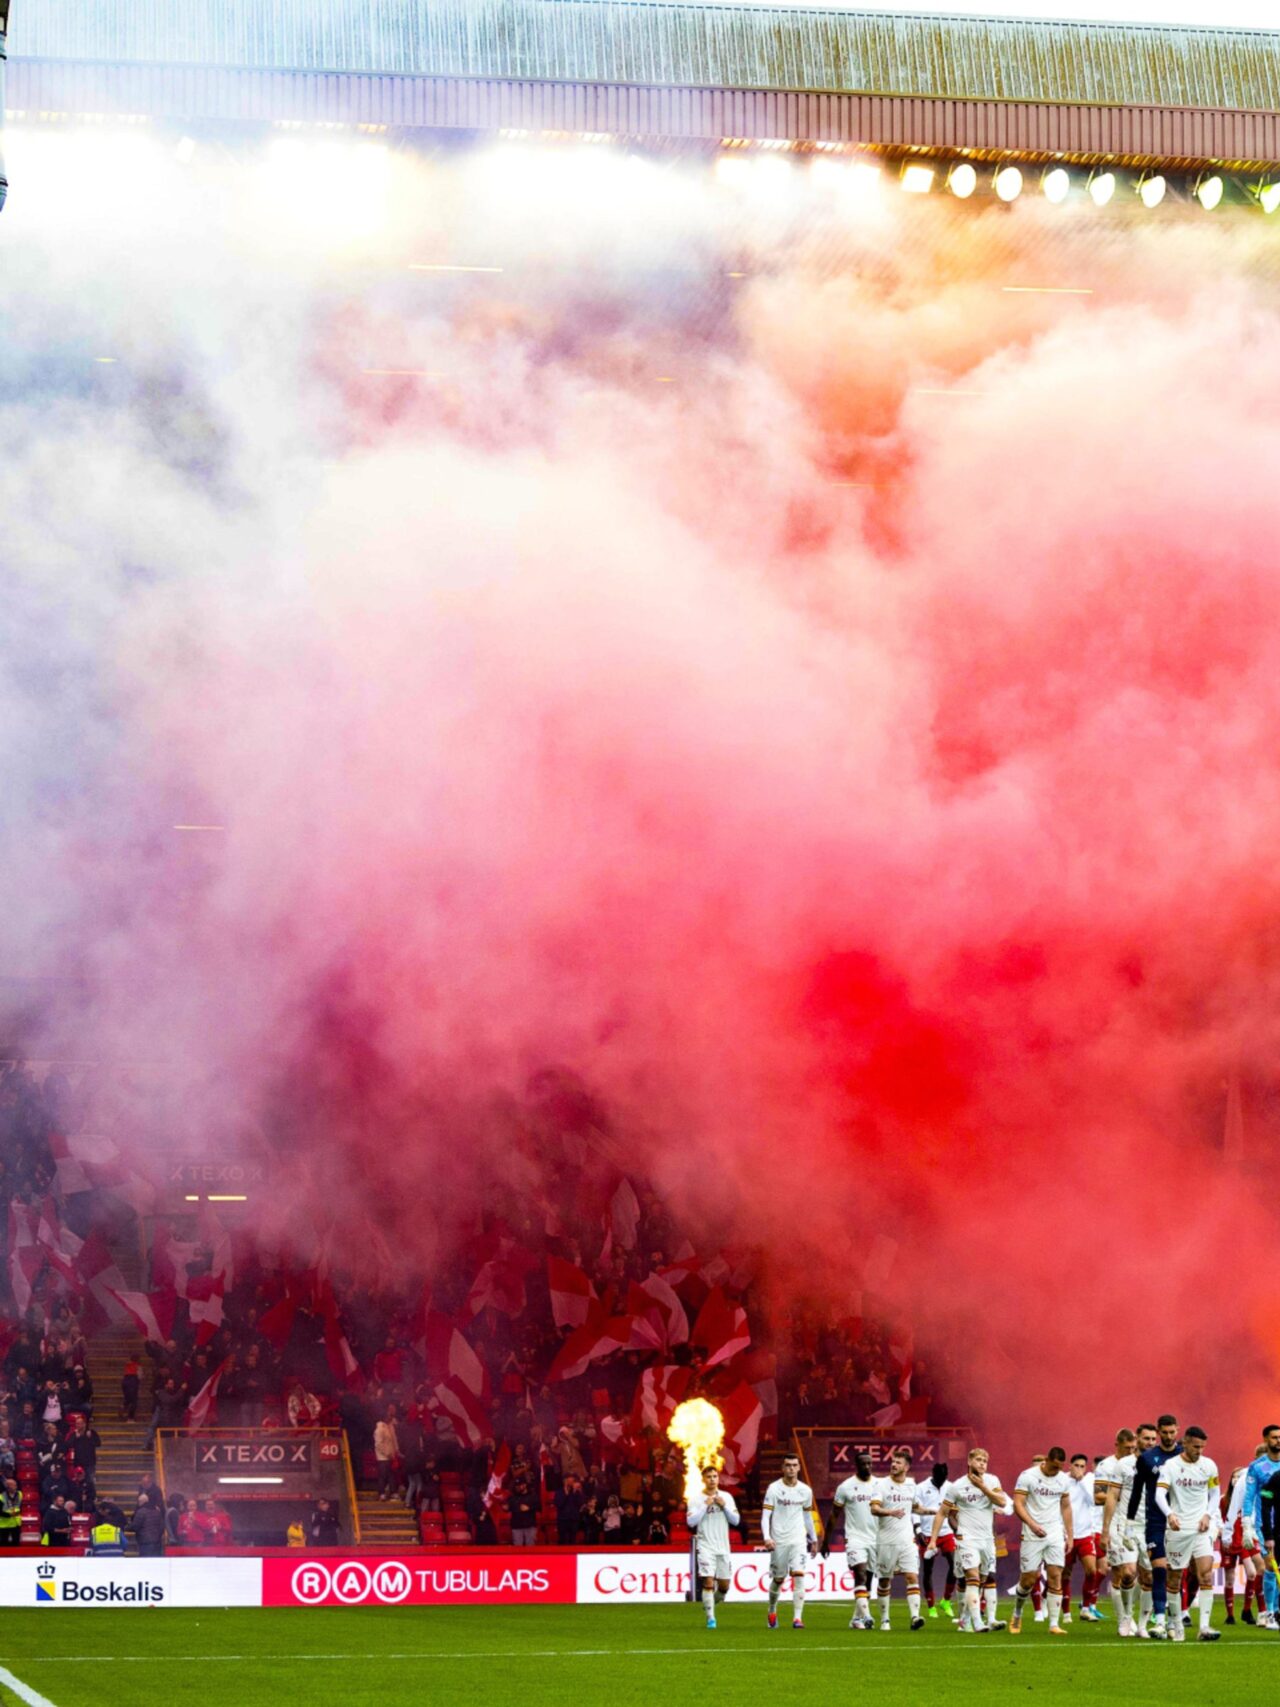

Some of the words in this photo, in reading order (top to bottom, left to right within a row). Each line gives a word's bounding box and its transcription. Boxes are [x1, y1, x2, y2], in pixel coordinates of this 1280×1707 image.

[188, 1165, 245, 1181] TEXO
[223, 1444, 285, 1463] TEXO
[320, 1443, 339, 1457] 40
[415, 1569, 550, 1592] TUBULARS
[594, 1566, 693, 1595] Centr
[733, 1563, 856, 1593] Coache
[62, 1581, 164, 1601] Boskalis
